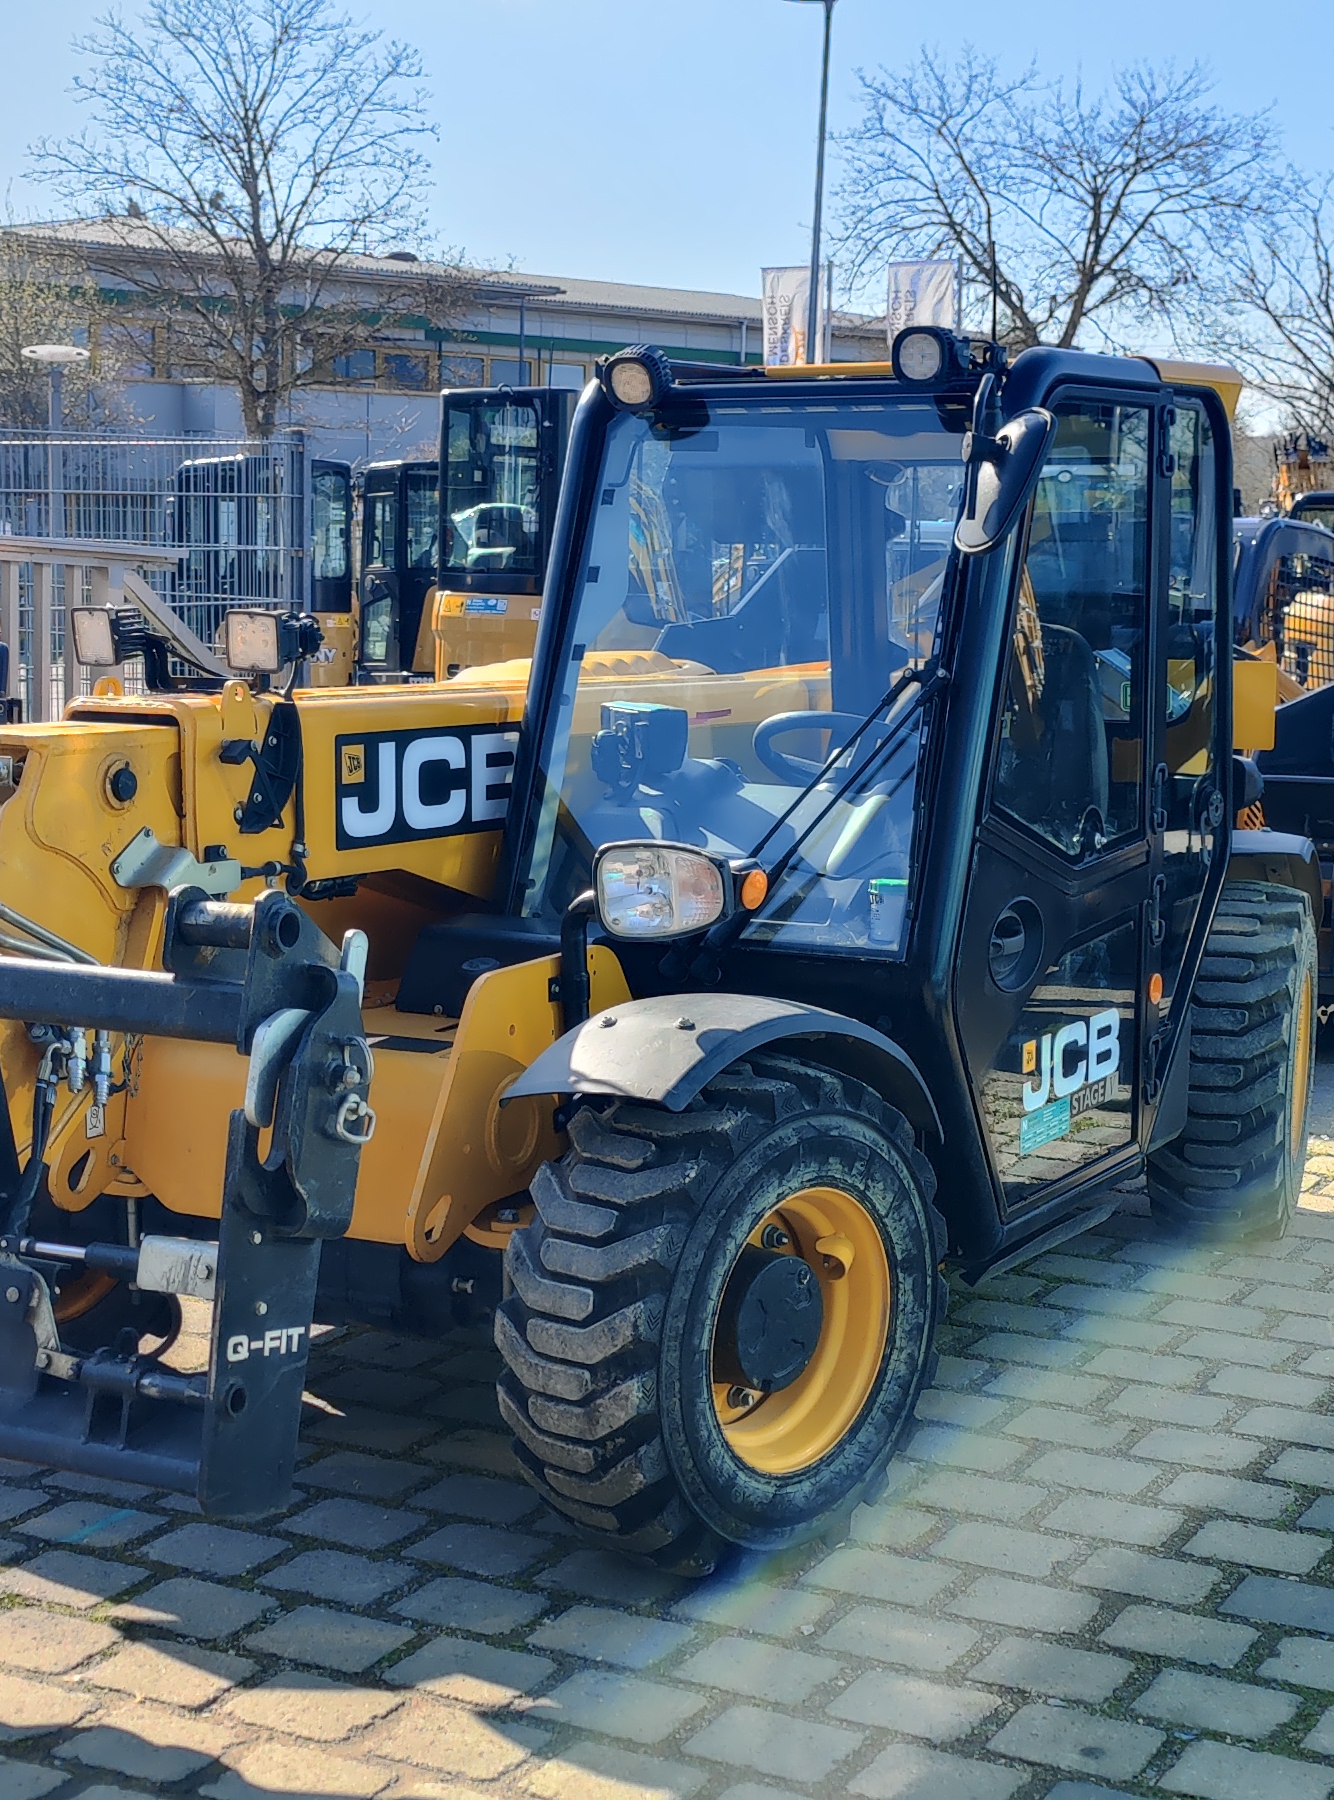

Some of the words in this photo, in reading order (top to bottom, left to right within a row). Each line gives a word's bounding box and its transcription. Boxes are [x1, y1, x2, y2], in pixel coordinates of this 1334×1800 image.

[342, 732, 520, 838] JCB
[1022, 1007, 1120, 1111] JCB
[1071, 1083, 1105, 1115] STAGE
[227, 1326, 306, 1362] Q-FIT
